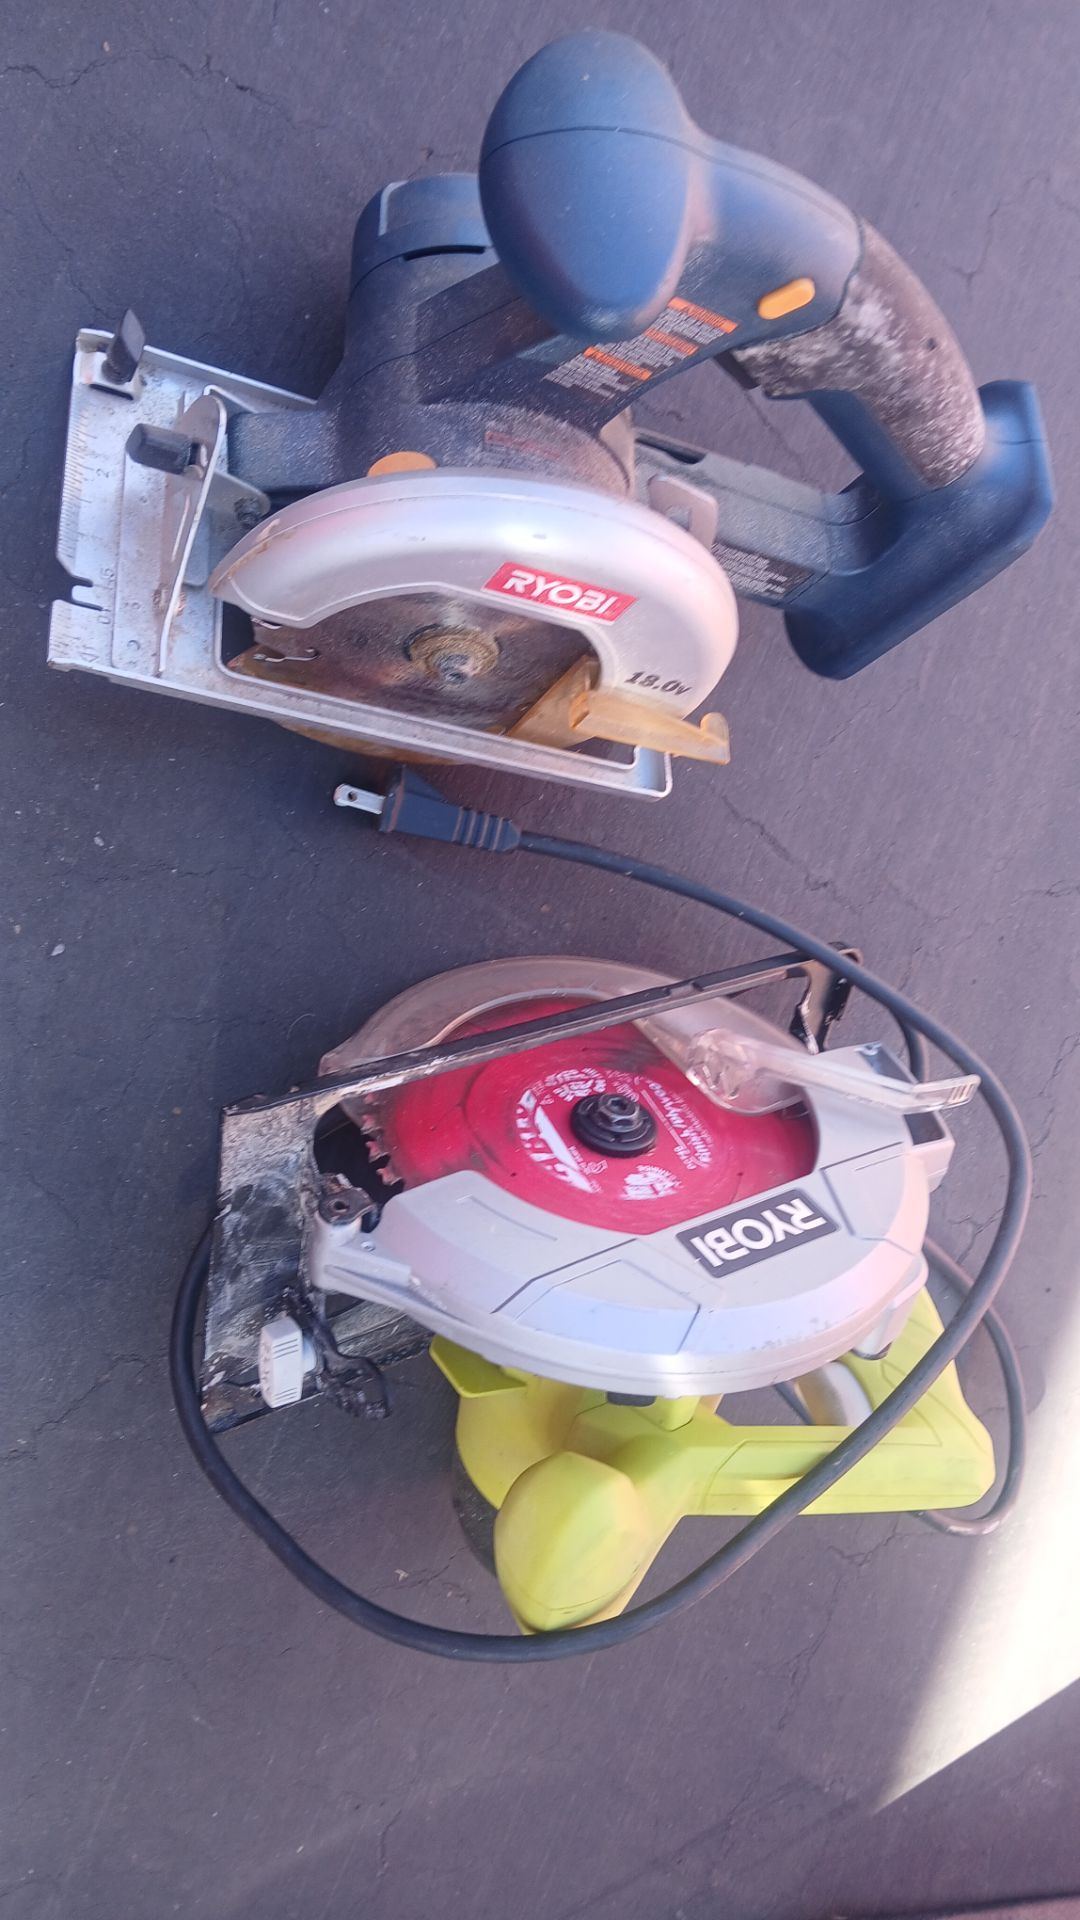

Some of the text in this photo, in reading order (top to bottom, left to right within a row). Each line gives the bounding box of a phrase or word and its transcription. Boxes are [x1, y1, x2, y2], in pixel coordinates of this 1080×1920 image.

[503, 569, 618, 615] RYOBI
[624, 670, 693, 696] 18.0v
[690, 1198, 828, 1267] RYOBI
